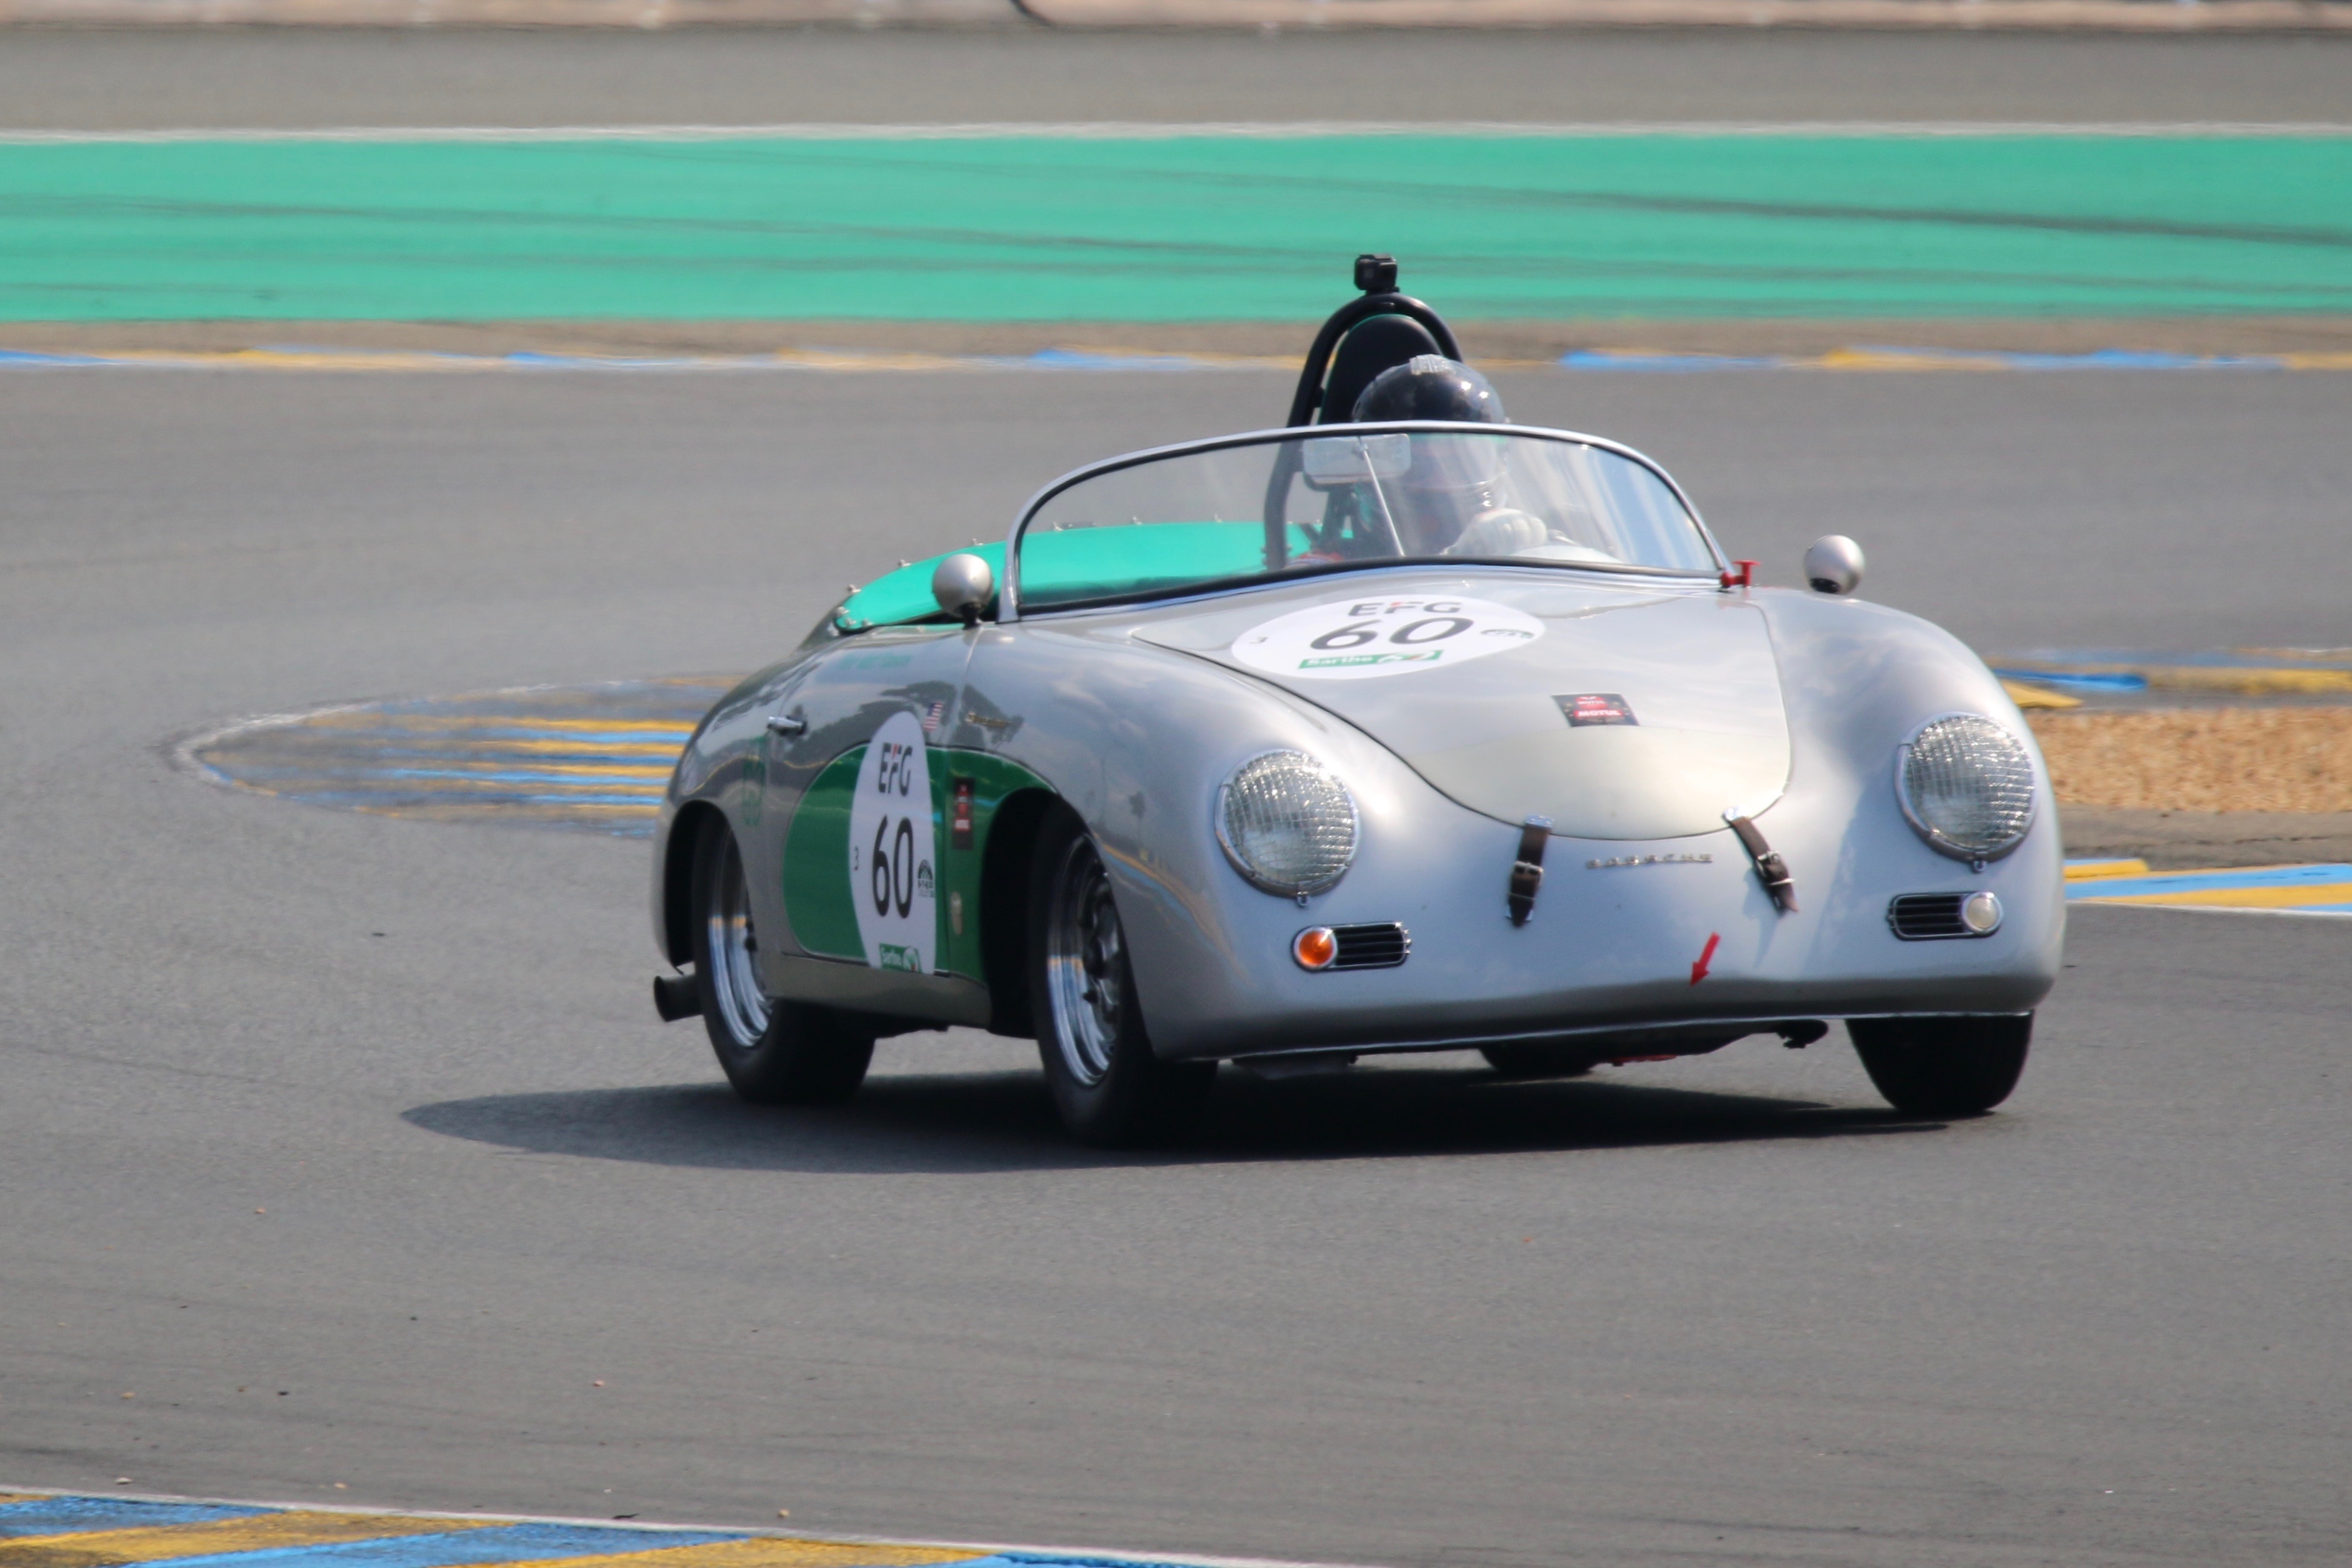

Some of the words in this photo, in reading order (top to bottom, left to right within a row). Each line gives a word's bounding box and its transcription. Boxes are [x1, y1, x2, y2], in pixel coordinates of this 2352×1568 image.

[1348, 601, 1462, 617] EFG
[1310, 617, 1474, 650] 60
[878, 744, 913, 796] EFG
[872, 814, 913, 918] 60
